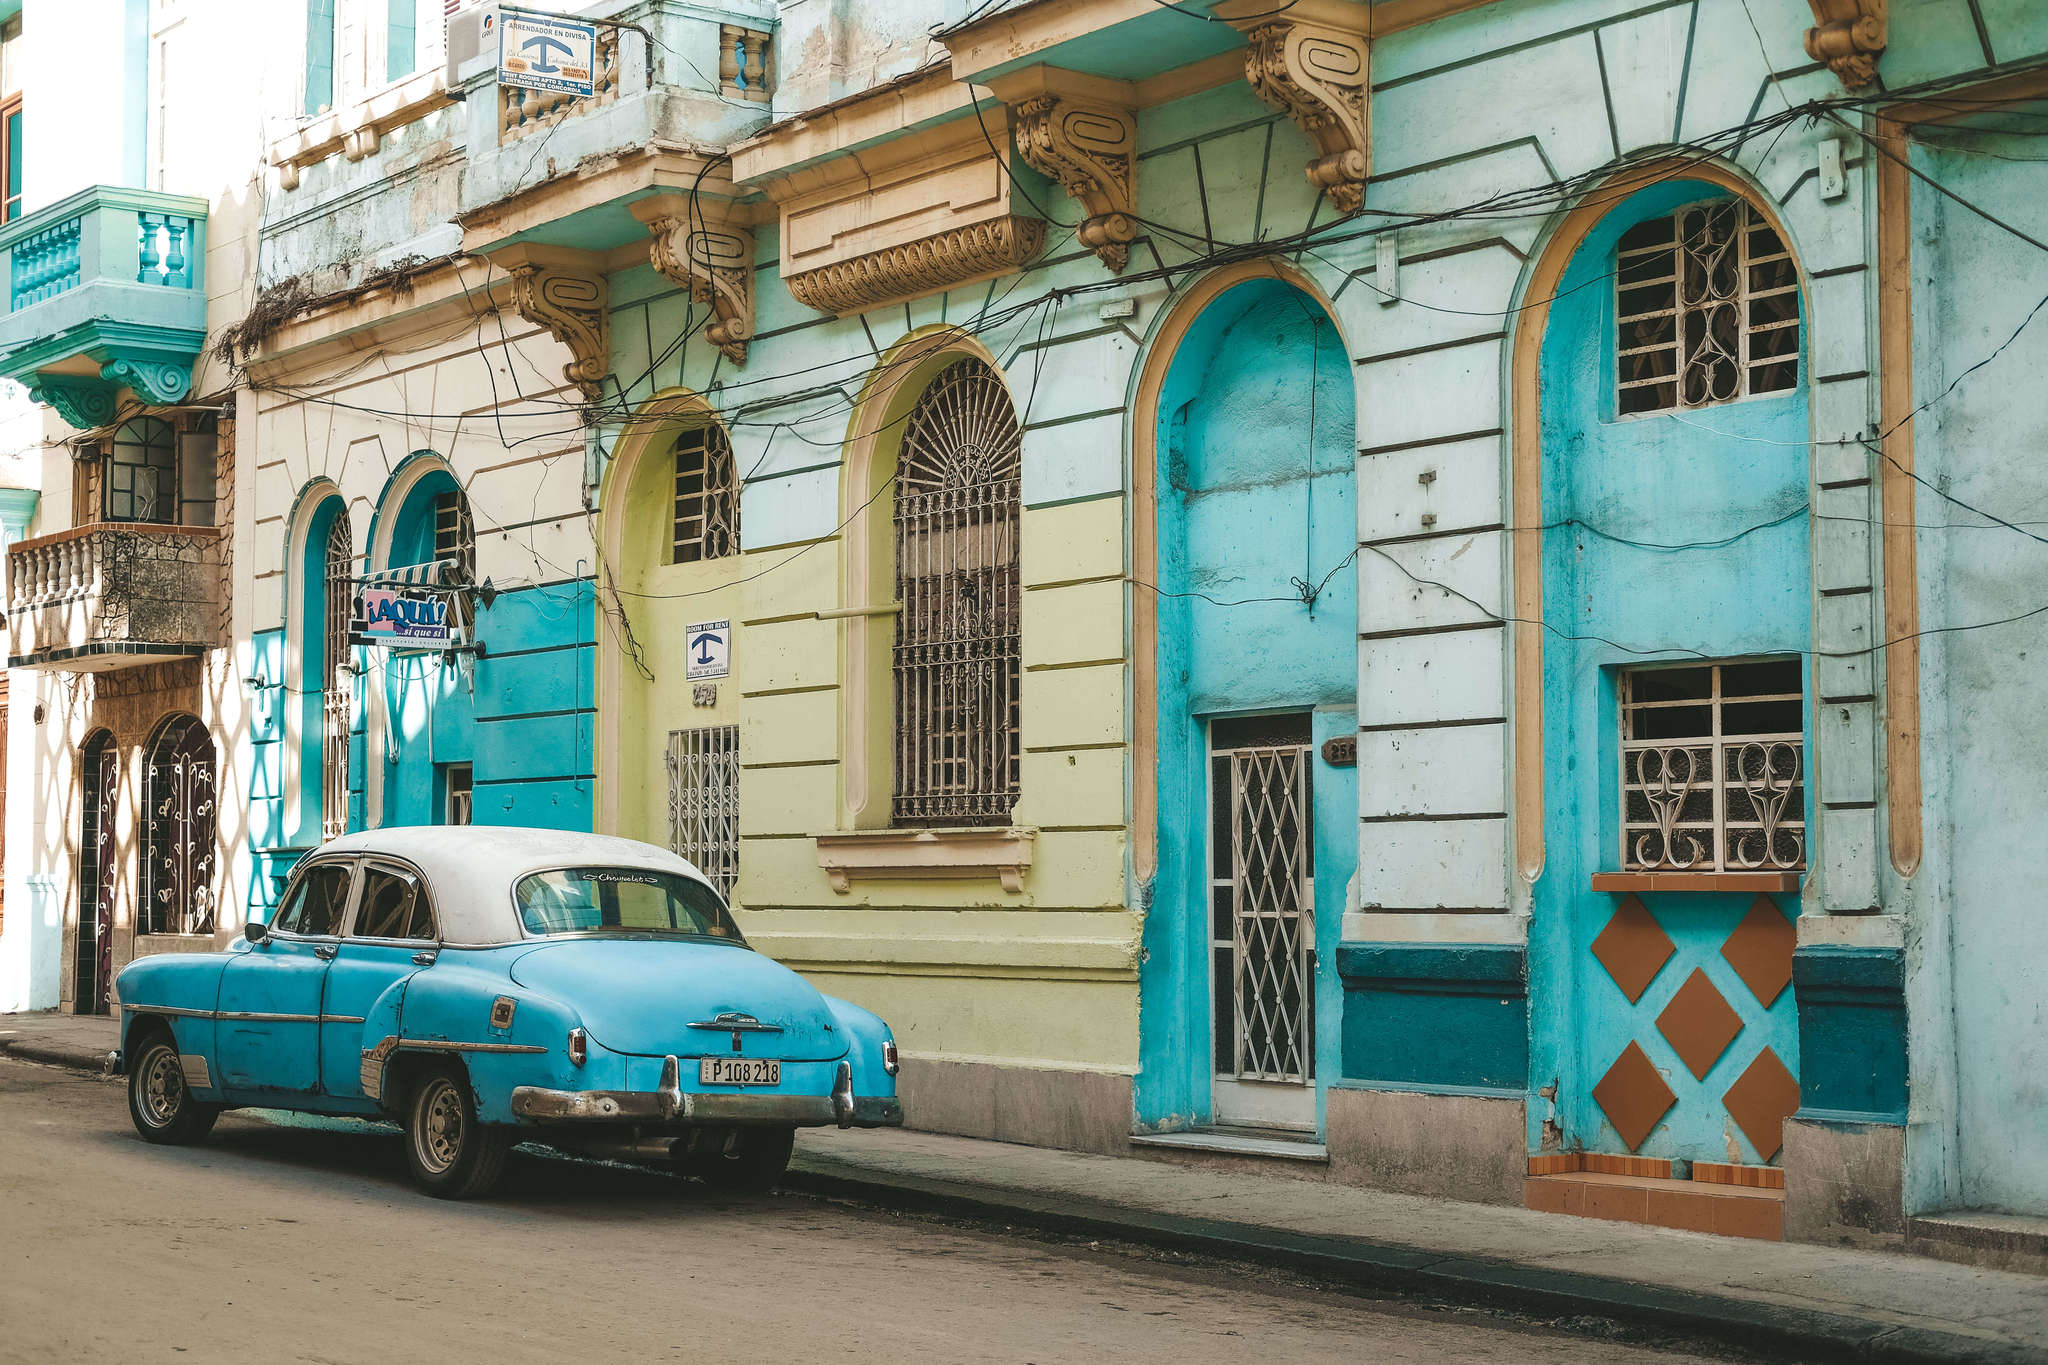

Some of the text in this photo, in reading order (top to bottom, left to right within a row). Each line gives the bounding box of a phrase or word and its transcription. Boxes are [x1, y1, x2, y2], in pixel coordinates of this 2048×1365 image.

[508, 22, 587, 40] ARRENDADOR EN DIVISA
[505, 77, 532, 86] ENTRADA
[548, 83, 582, 93] CONCORDIA
[367, 596, 446, 629] ¡AQUÍ!
[413, 629, 432, 637] que
[687, 621, 729, 633] ROOM FOR RENT
[713, 1062, 779, 1082] P 108 218
